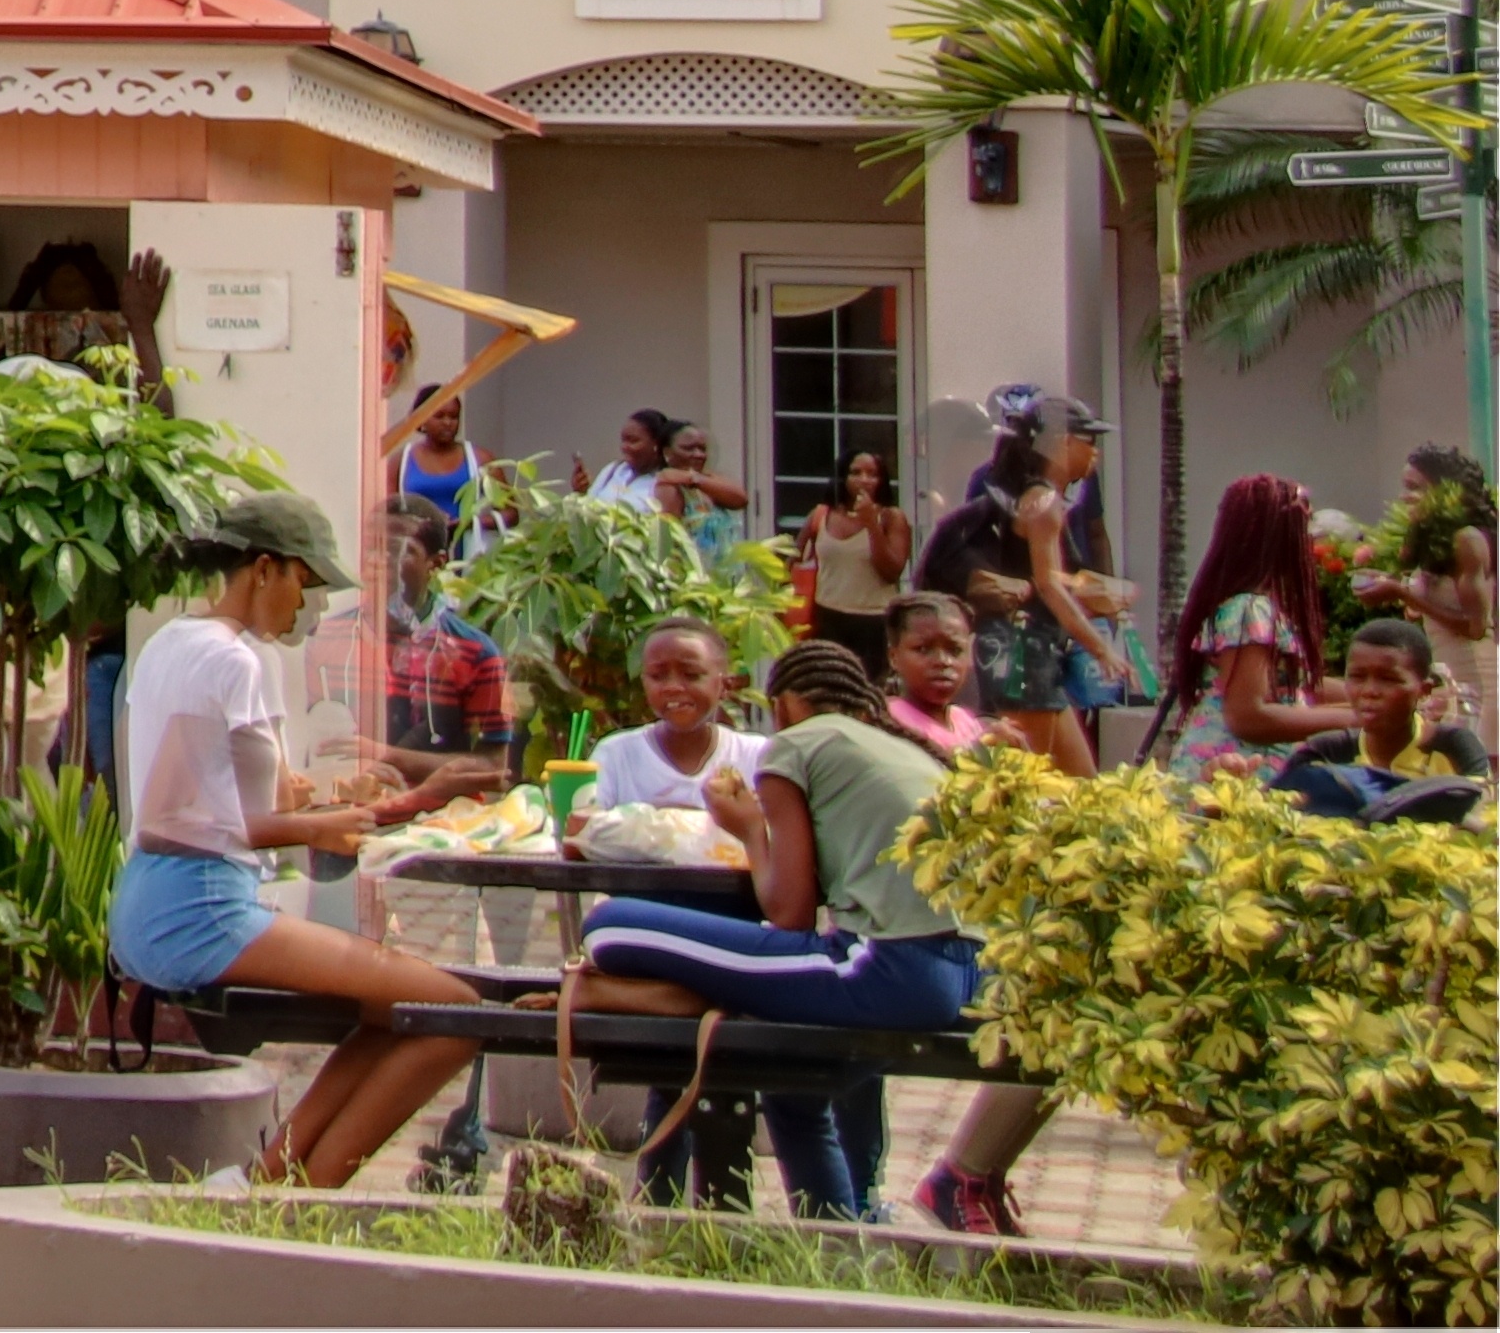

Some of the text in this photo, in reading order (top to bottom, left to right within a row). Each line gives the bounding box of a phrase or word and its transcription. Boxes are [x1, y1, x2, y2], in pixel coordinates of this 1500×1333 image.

[207, 283, 262, 296] SEA GLASS
[205, 316, 261, 330] GRENADA
